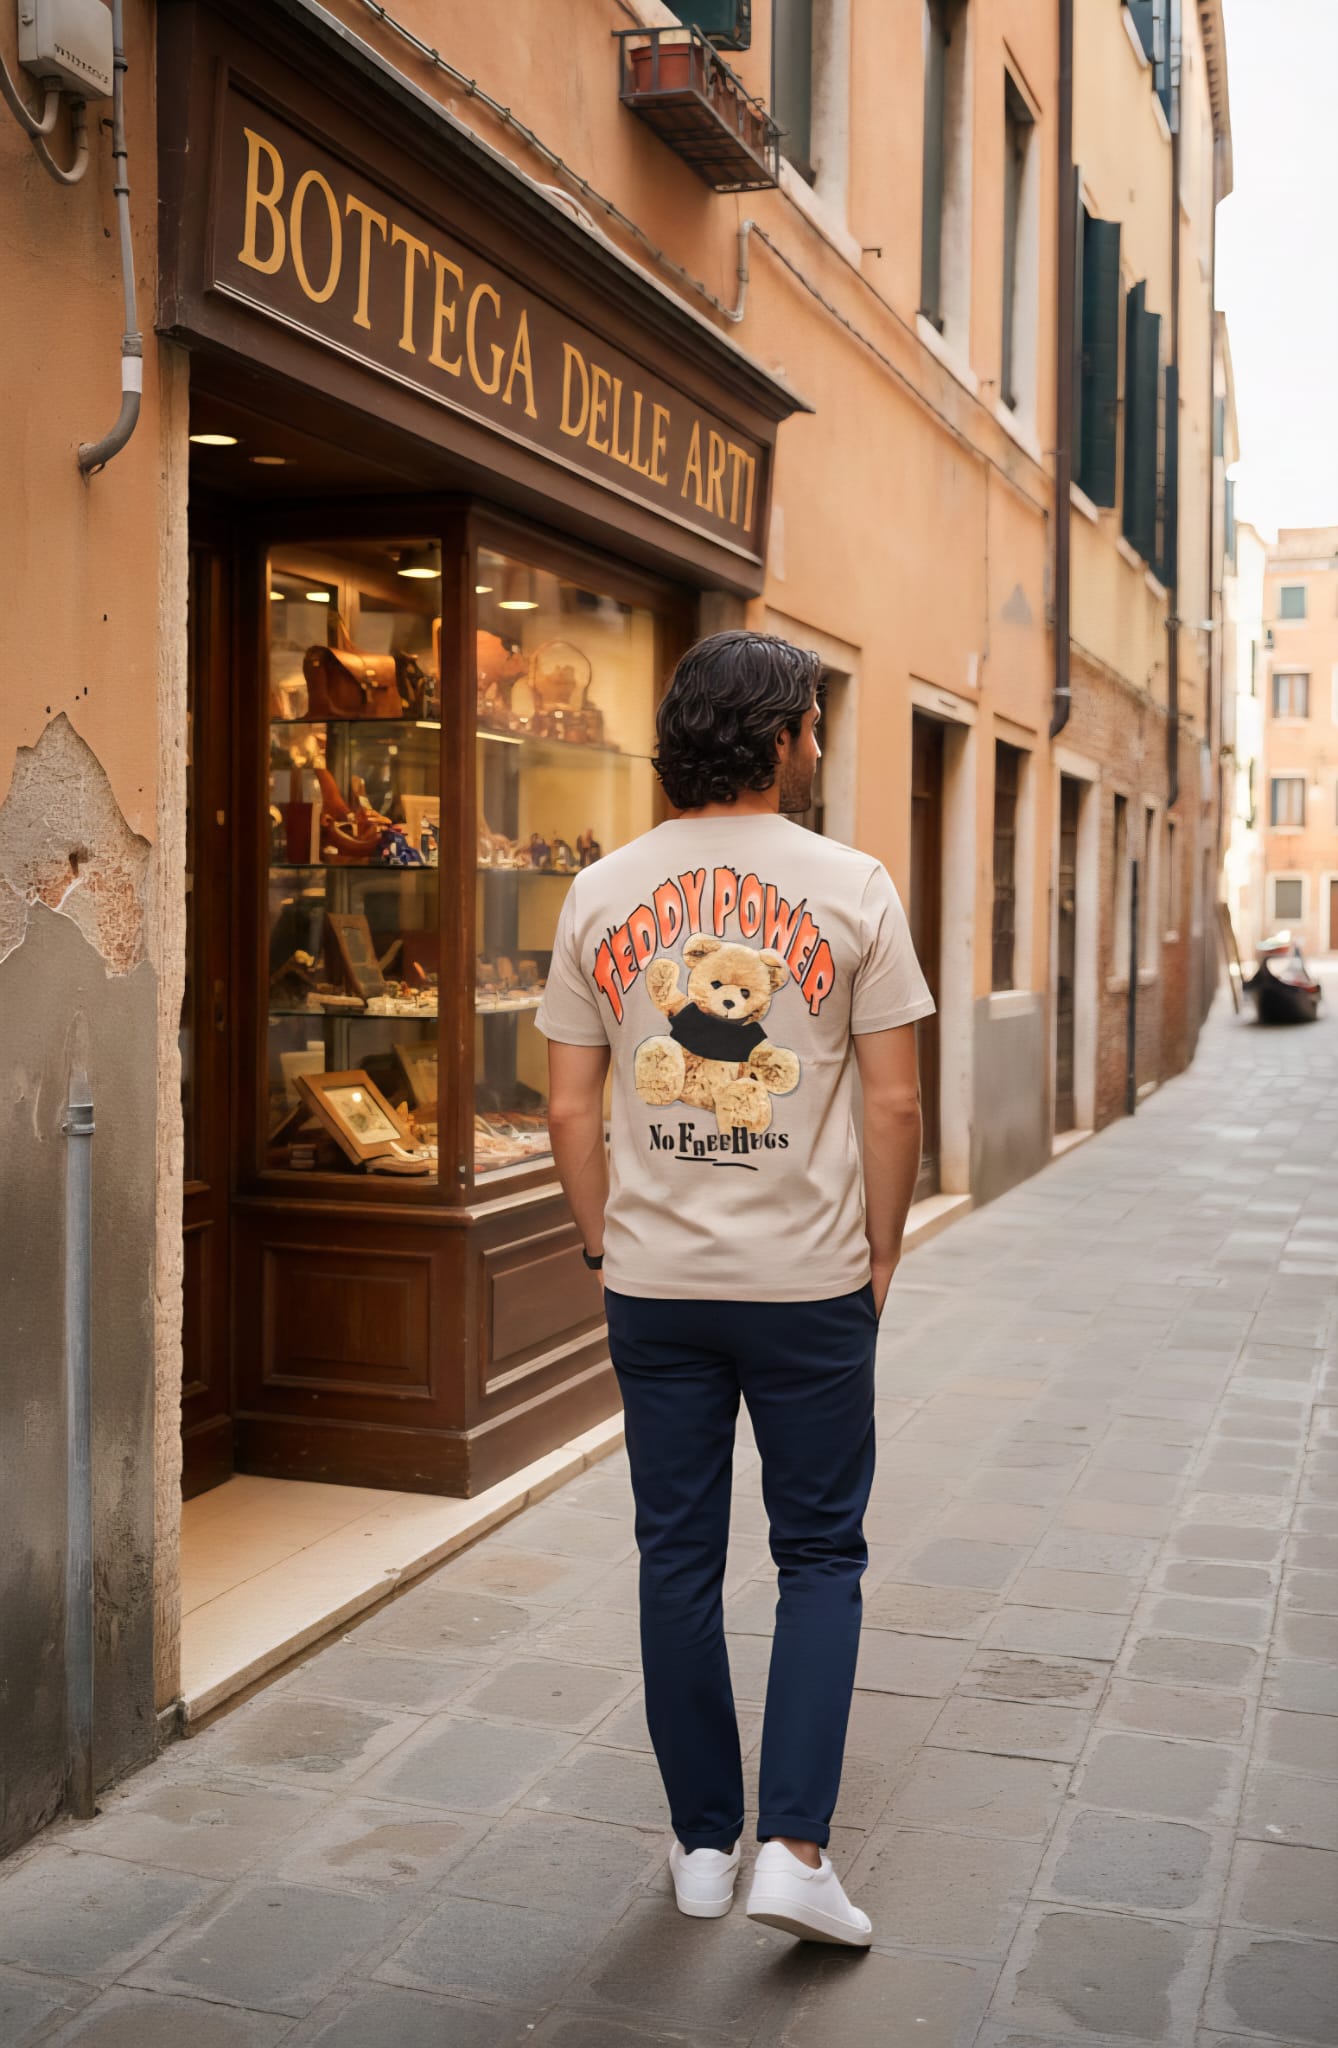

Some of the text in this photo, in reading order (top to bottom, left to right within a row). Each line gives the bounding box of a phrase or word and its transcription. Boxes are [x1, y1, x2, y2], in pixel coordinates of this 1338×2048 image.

[238, 127, 756, 533] BOTTEGA DELLE ARTI
[593, 865, 835, 1025] TEDDY POWER
